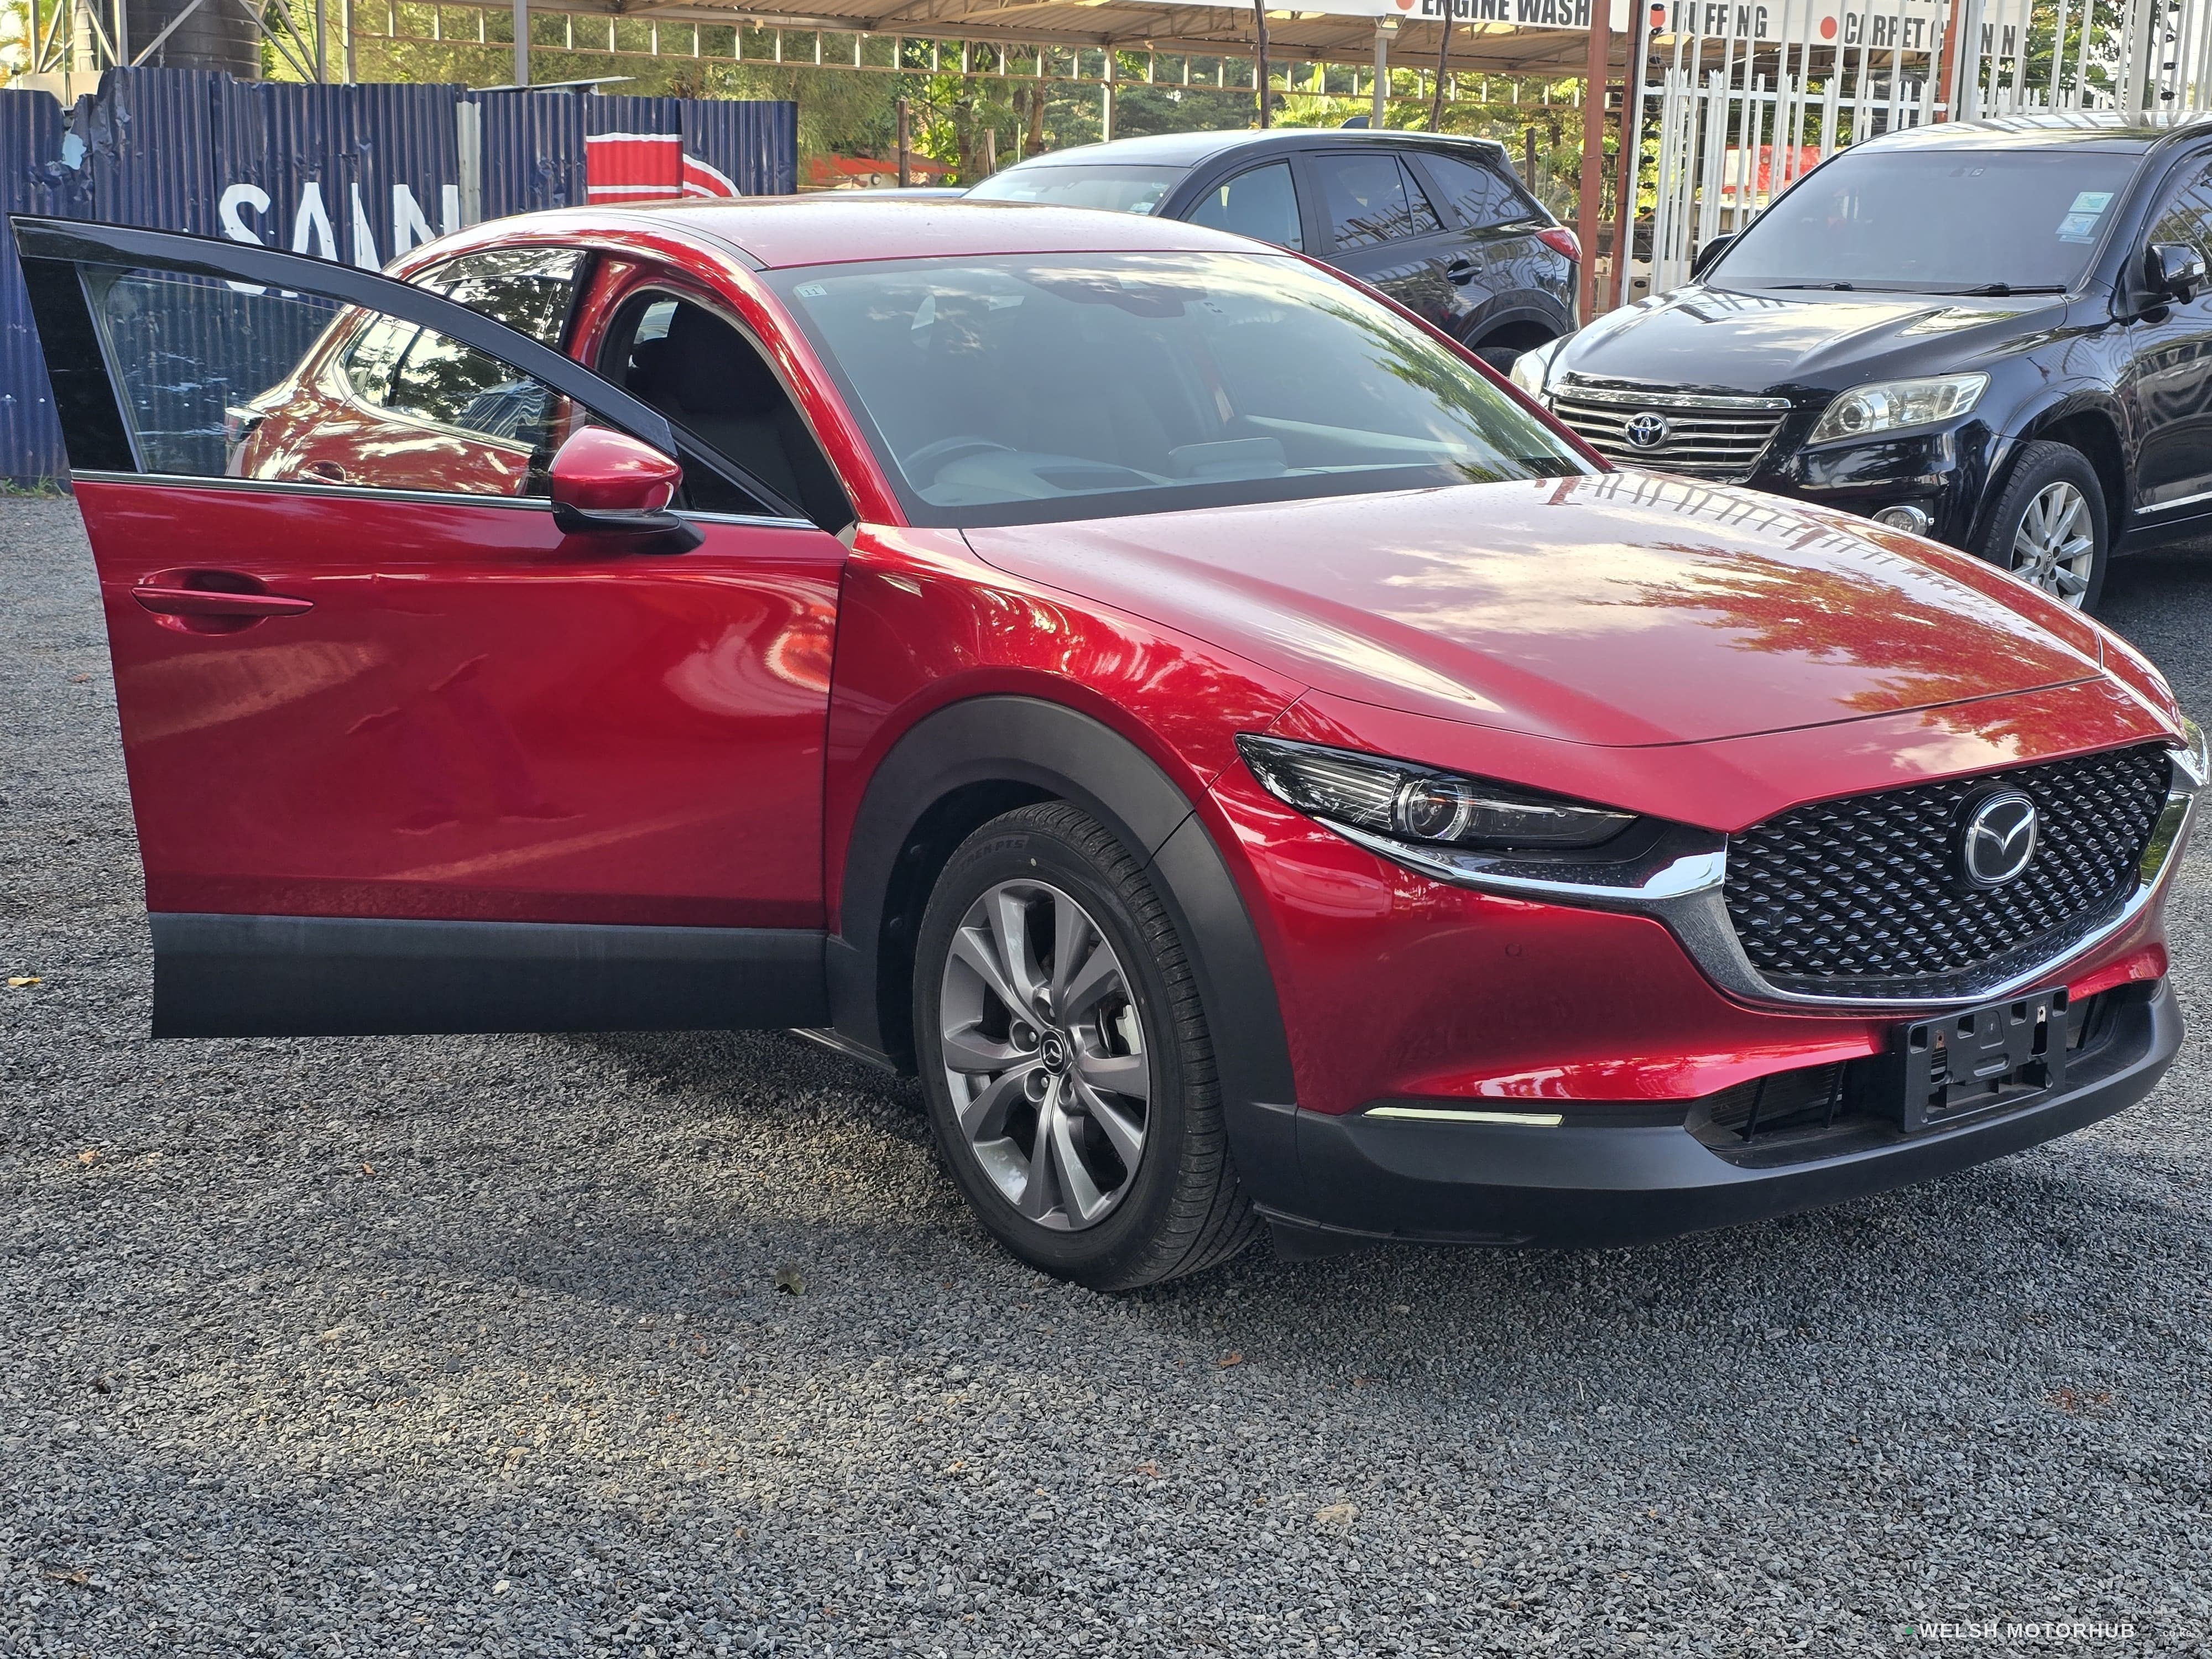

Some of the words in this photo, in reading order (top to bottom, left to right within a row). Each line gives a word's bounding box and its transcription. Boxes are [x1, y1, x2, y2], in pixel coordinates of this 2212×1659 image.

[1422, 0, 1509, 20] EGINE
[1518, 0, 1590, 26] WASH
[1671, 1, 1767, 38] BUFFNG
